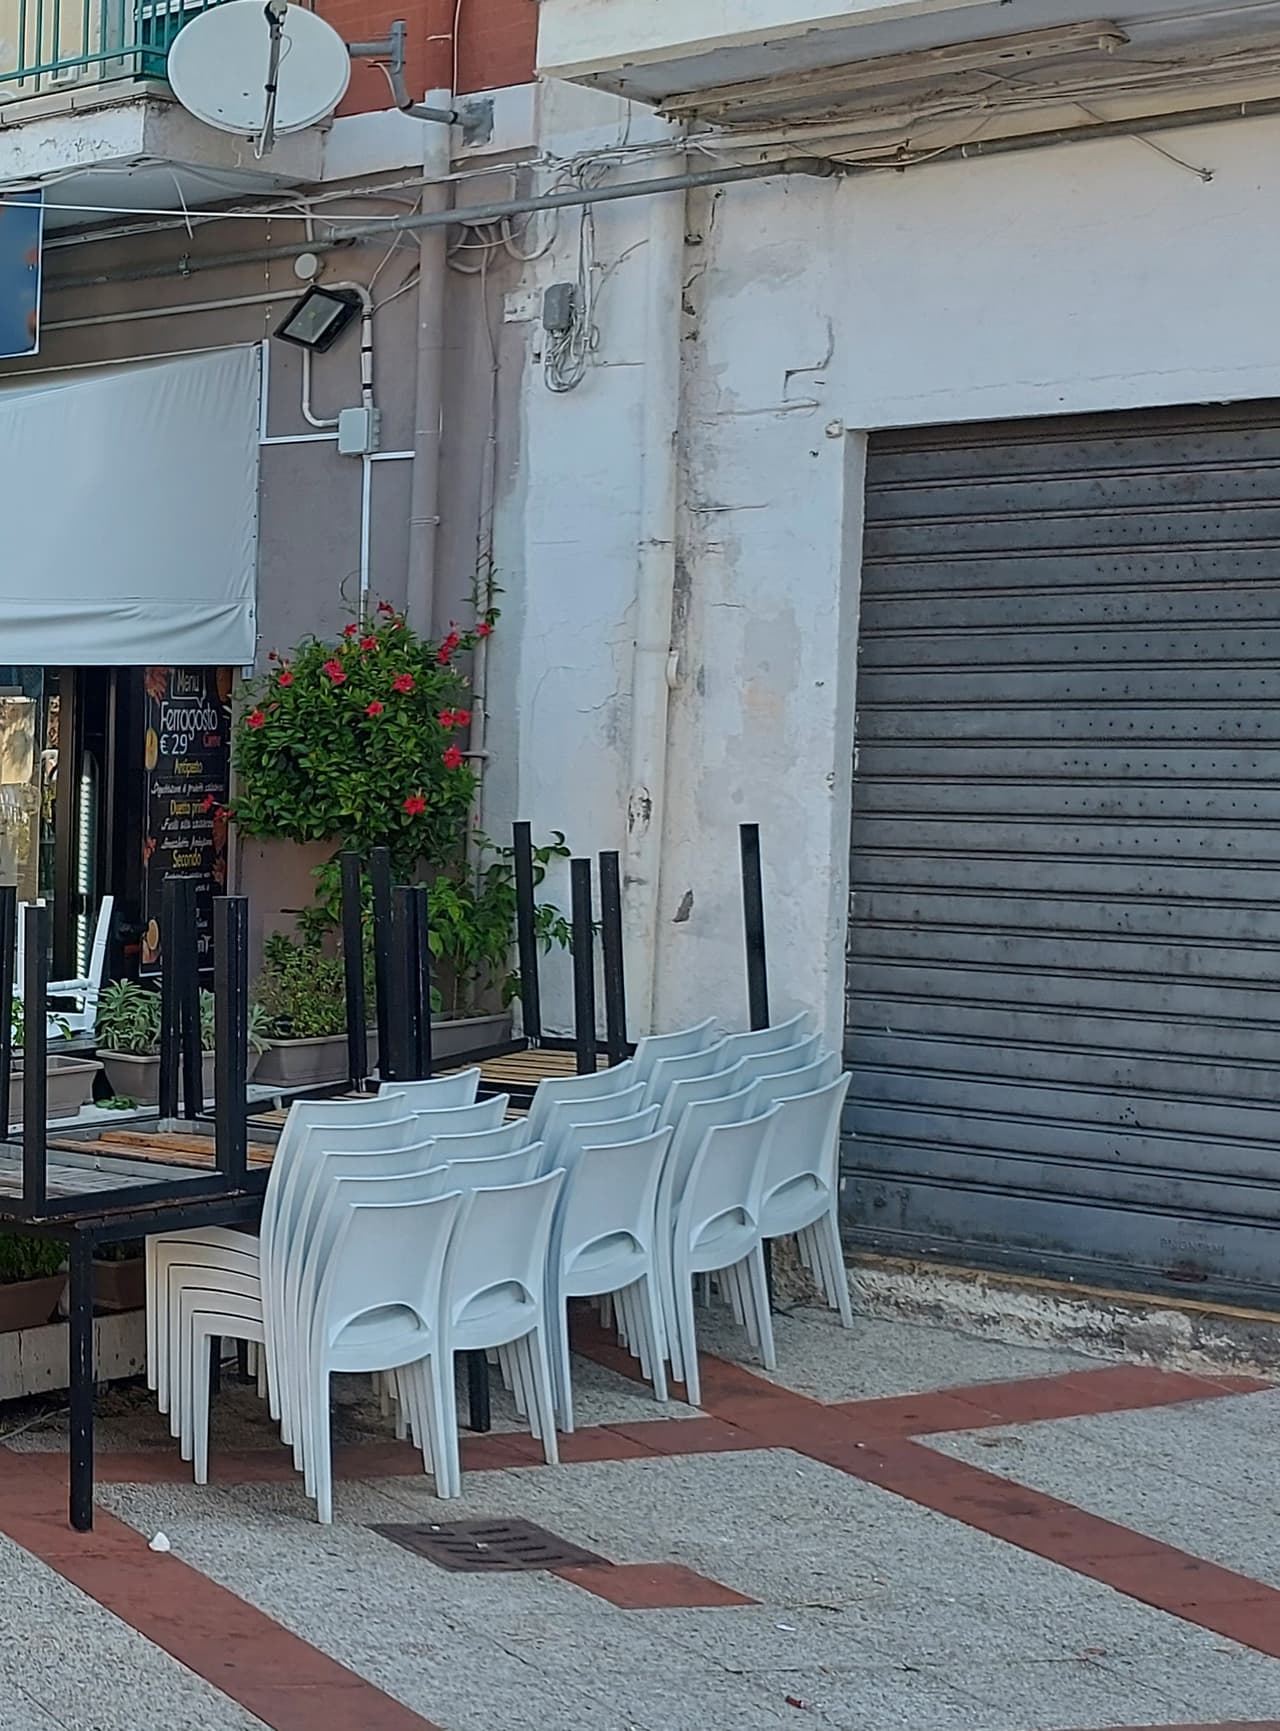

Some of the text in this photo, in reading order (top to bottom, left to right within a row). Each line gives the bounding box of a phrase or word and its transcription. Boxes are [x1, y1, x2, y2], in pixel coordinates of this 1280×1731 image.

[160, 701, 218, 741] Ferragosto
[160, 733, 188, 754] € 29
[192, 799, 208, 817] prim
[172, 848, 202, 868] Secondo
